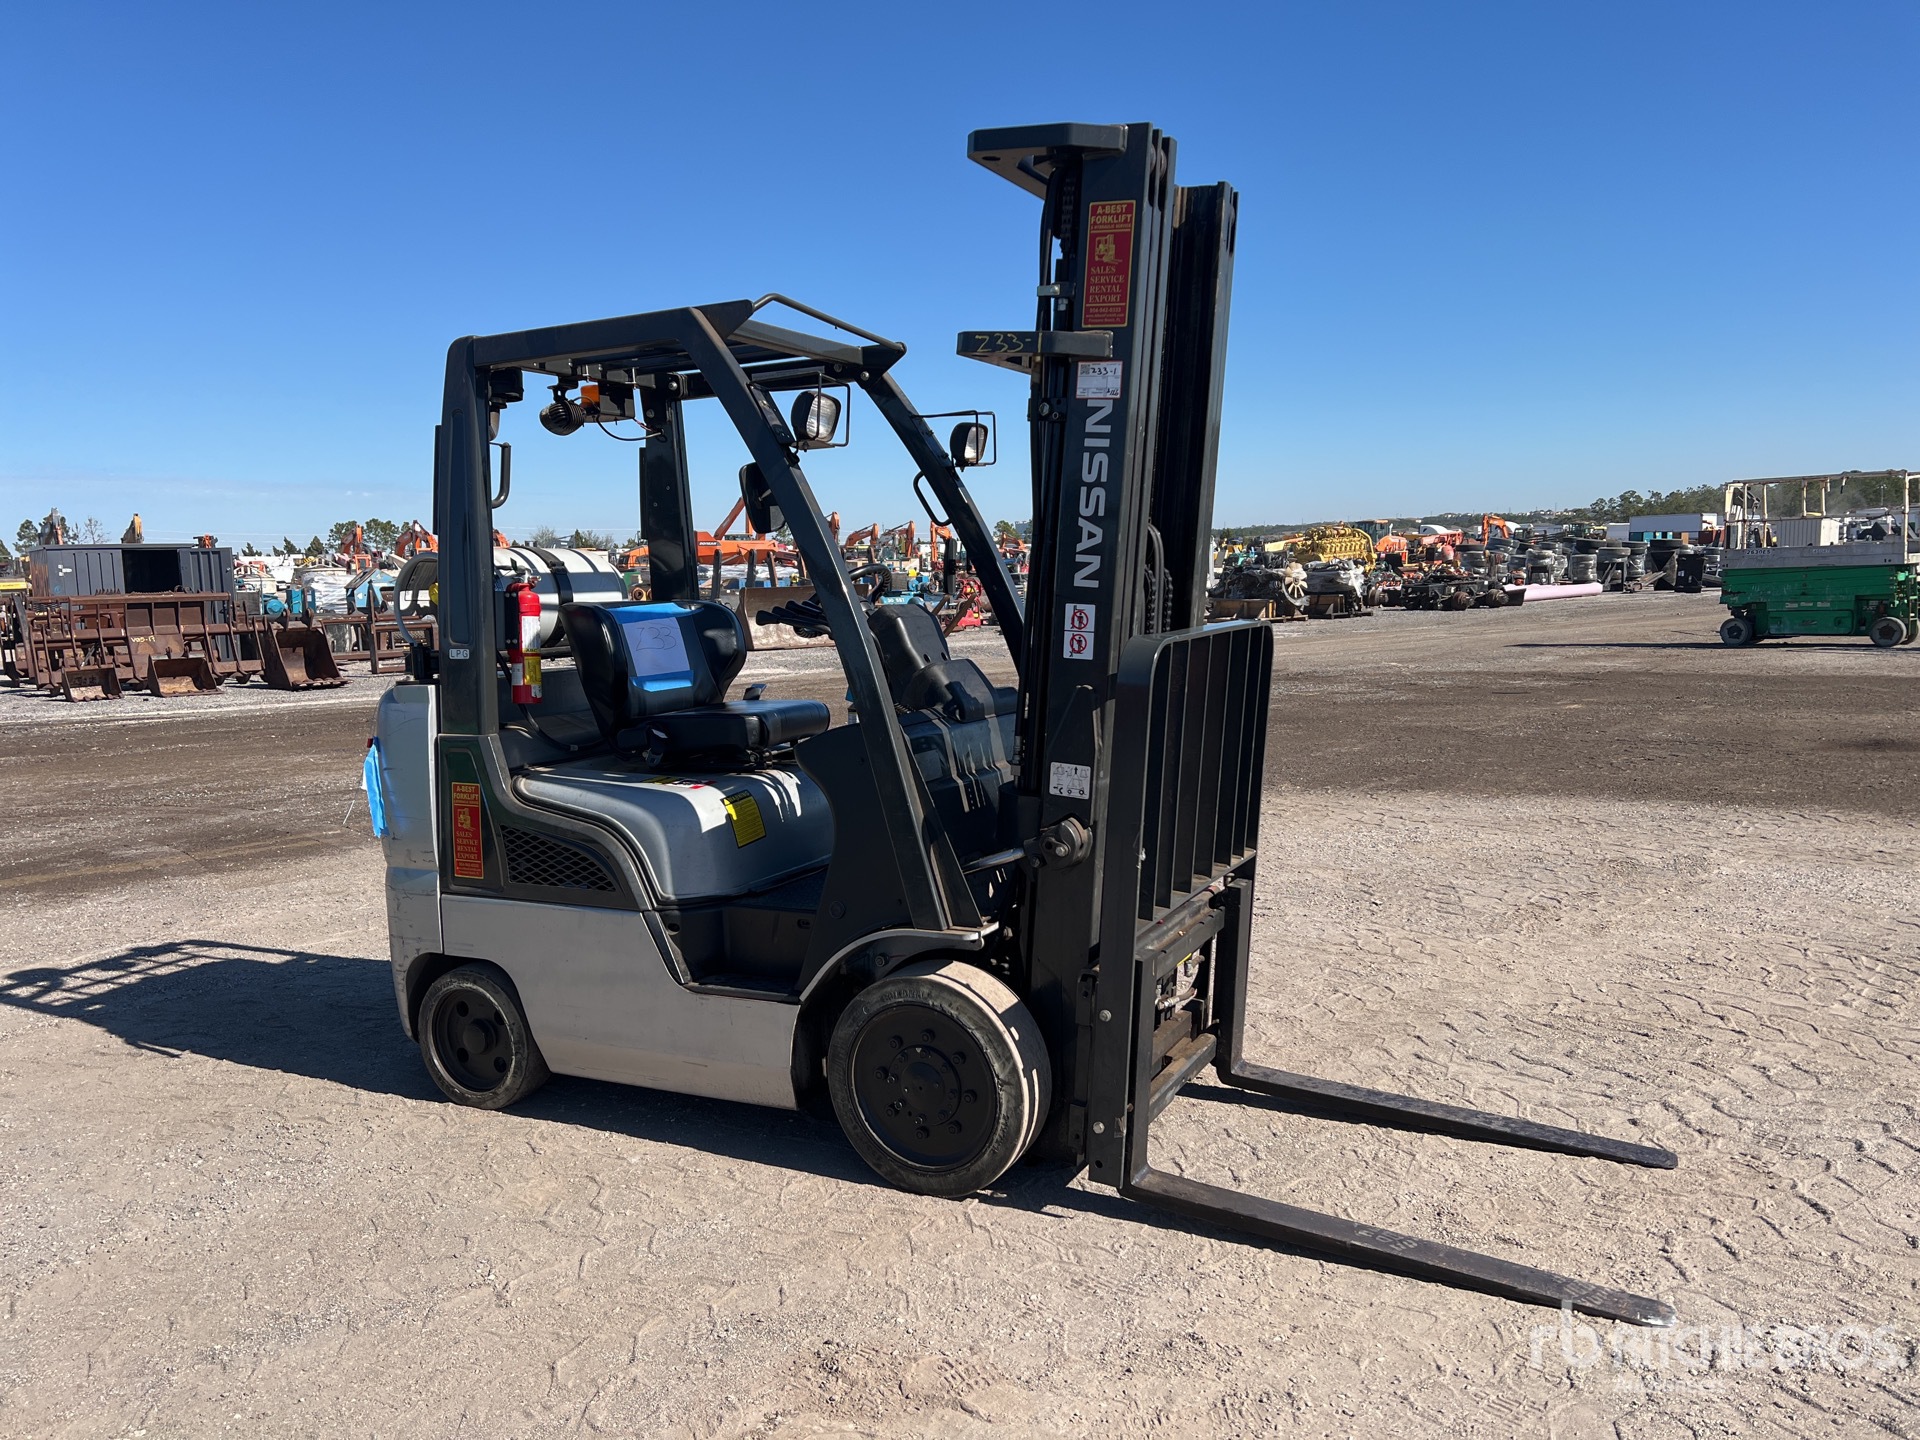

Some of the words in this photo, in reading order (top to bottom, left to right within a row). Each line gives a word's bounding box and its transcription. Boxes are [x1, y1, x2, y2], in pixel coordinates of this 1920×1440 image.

[1097, 204, 1128, 215] A-BEST
[1091, 214, 1132, 225] FORKLIFT
[1090, 266, 1116, 275] SALES
[1090, 275, 1125, 284] SERVICE
[1089, 285, 1122, 294] RENTAL
[1089, 295, 1122, 303] EXPORT
[1073, 399, 1114, 589] NISSAN
[450, 649, 469, 658] LPG
[456, 785, 475, 793] A-BEST
[453, 792, 479, 801] FORKLIFT
[456, 830, 473, 838] SALES
[456, 838, 479, 846] SERVICE
[457, 845, 478, 853] RENTAL
[457, 852, 478, 860] EXPORT
